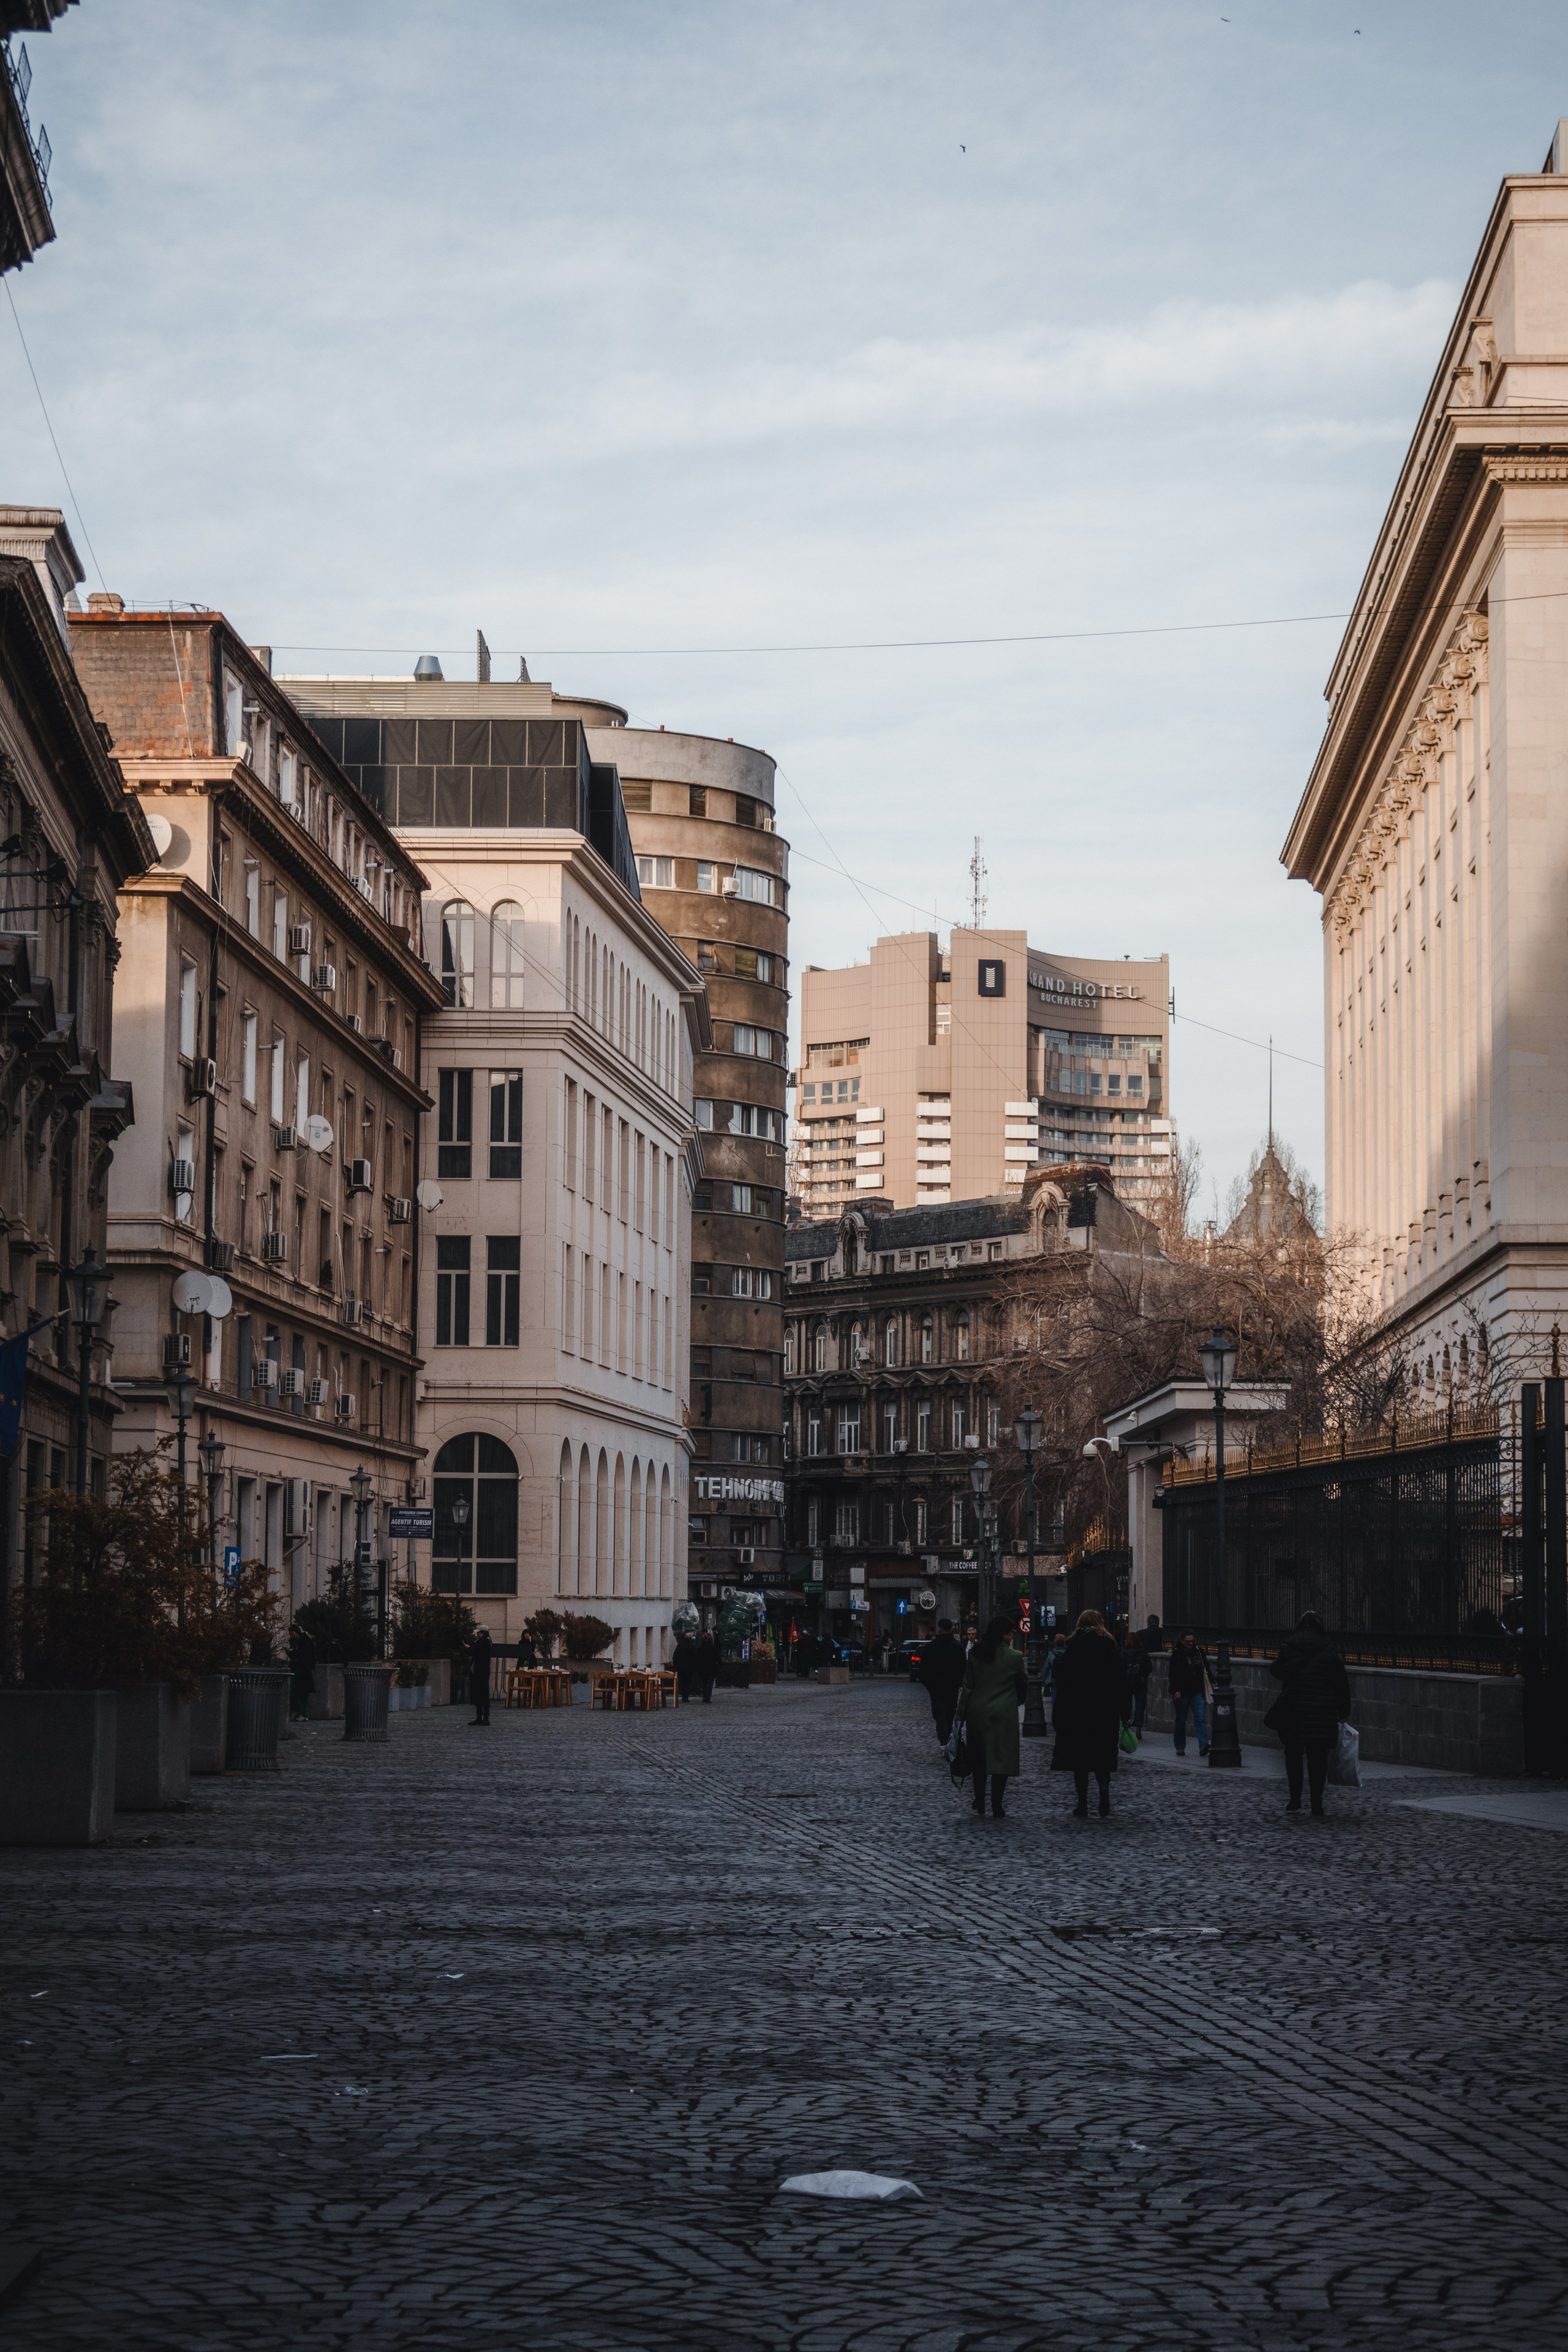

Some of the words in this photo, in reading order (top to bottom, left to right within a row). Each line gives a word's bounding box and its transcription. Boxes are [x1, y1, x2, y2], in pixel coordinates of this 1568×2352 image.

[1030, 971, 1065, 993] GRAND
[1073, 982, 1137, 999] HOTEL
[1041, 992, 1098, 1009] BUCHAREST
